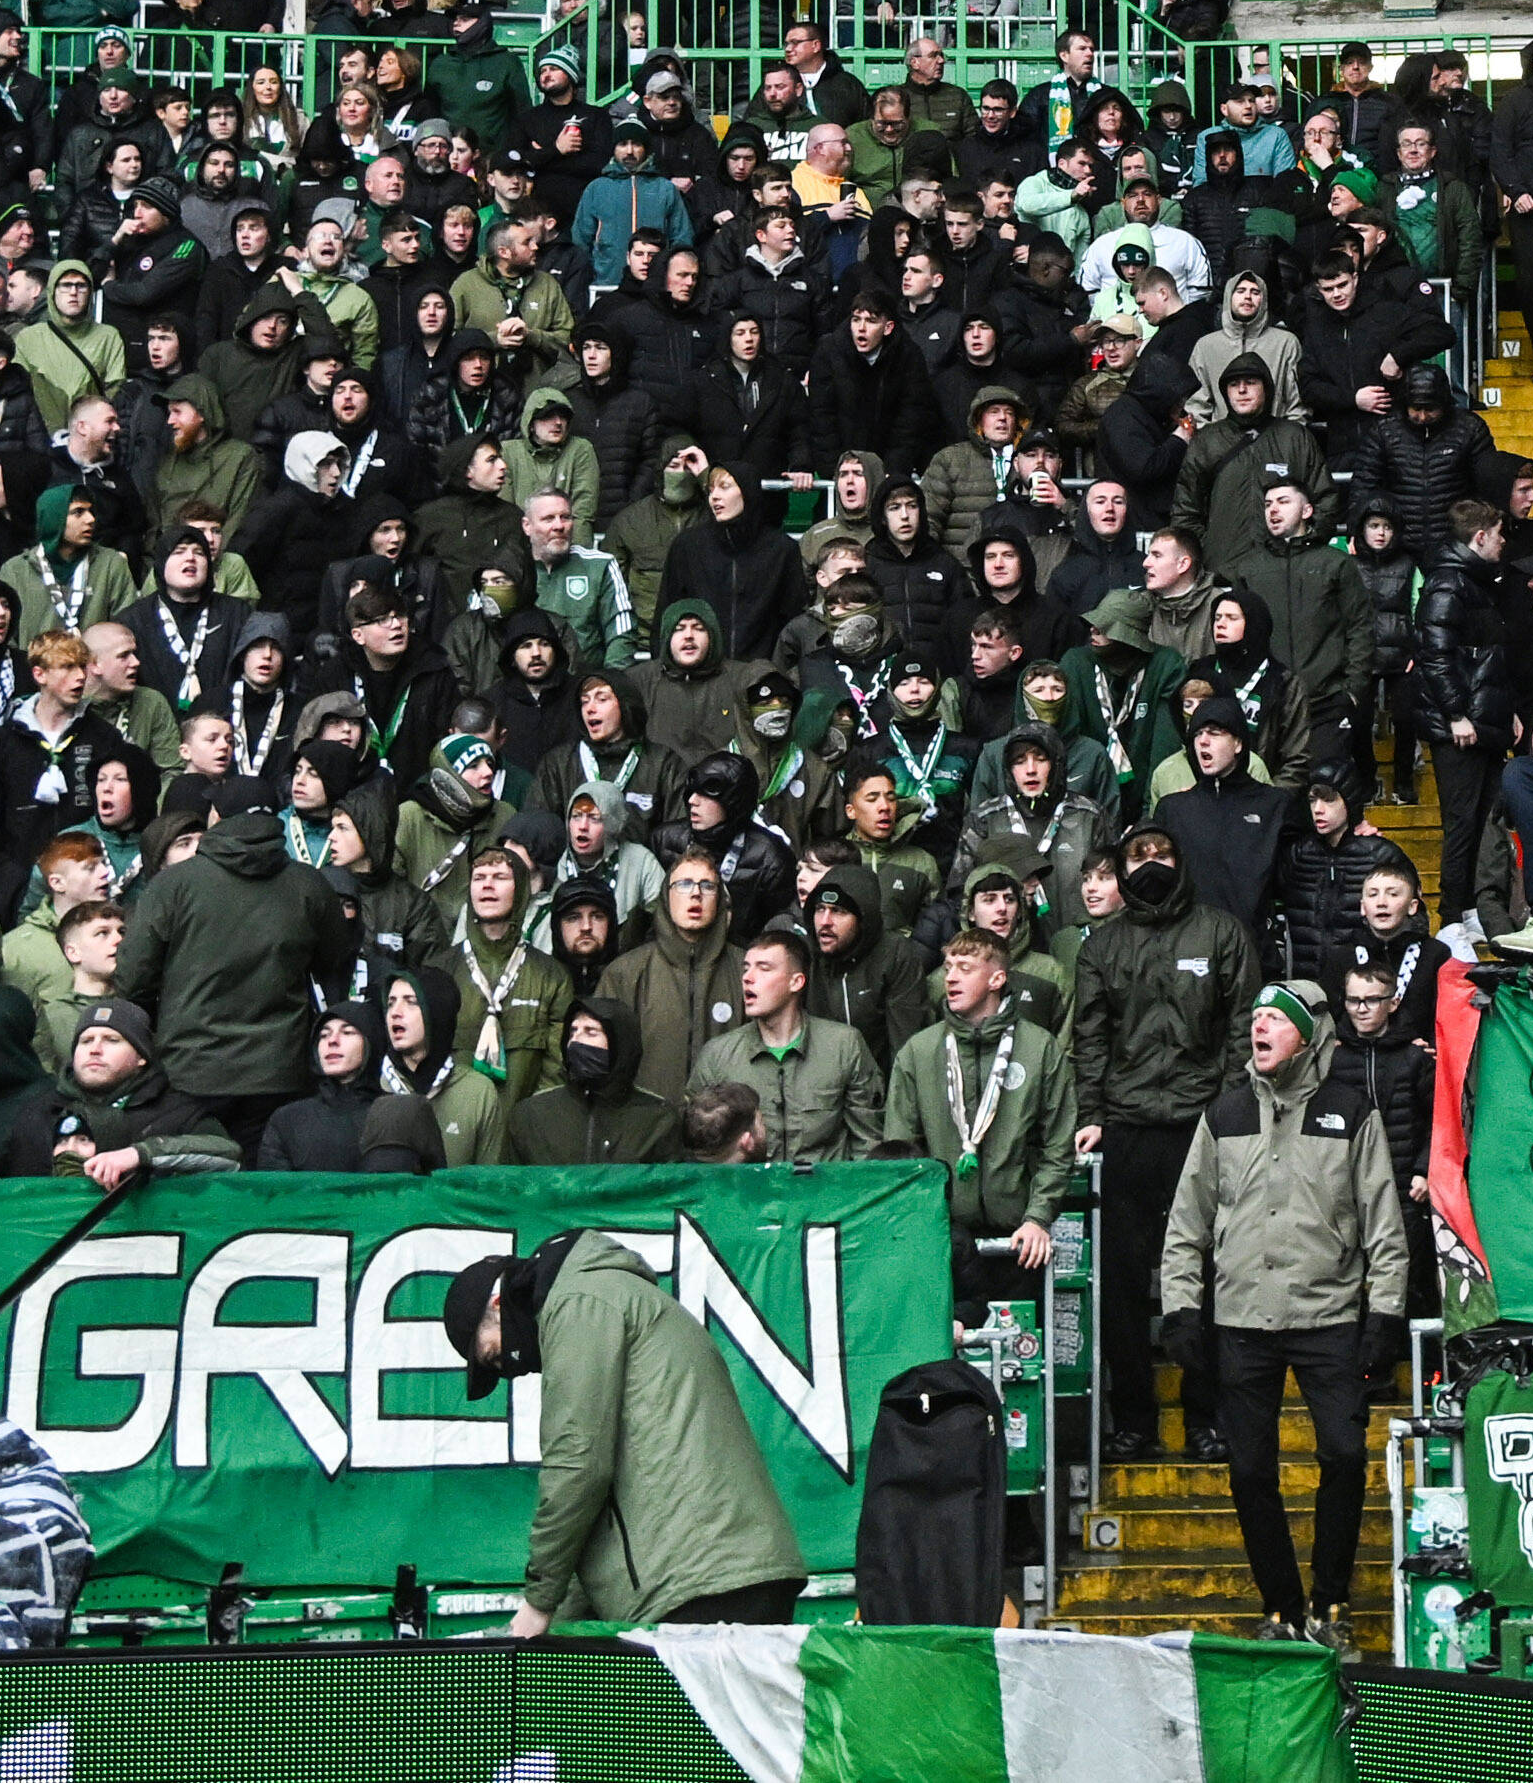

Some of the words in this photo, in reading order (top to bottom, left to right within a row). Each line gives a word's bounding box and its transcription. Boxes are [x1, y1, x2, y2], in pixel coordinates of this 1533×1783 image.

[1504, 340, 1518, 357] V
[1486, 389, 1499, 405] U
[1095, 1520, 1117, 1547] C
